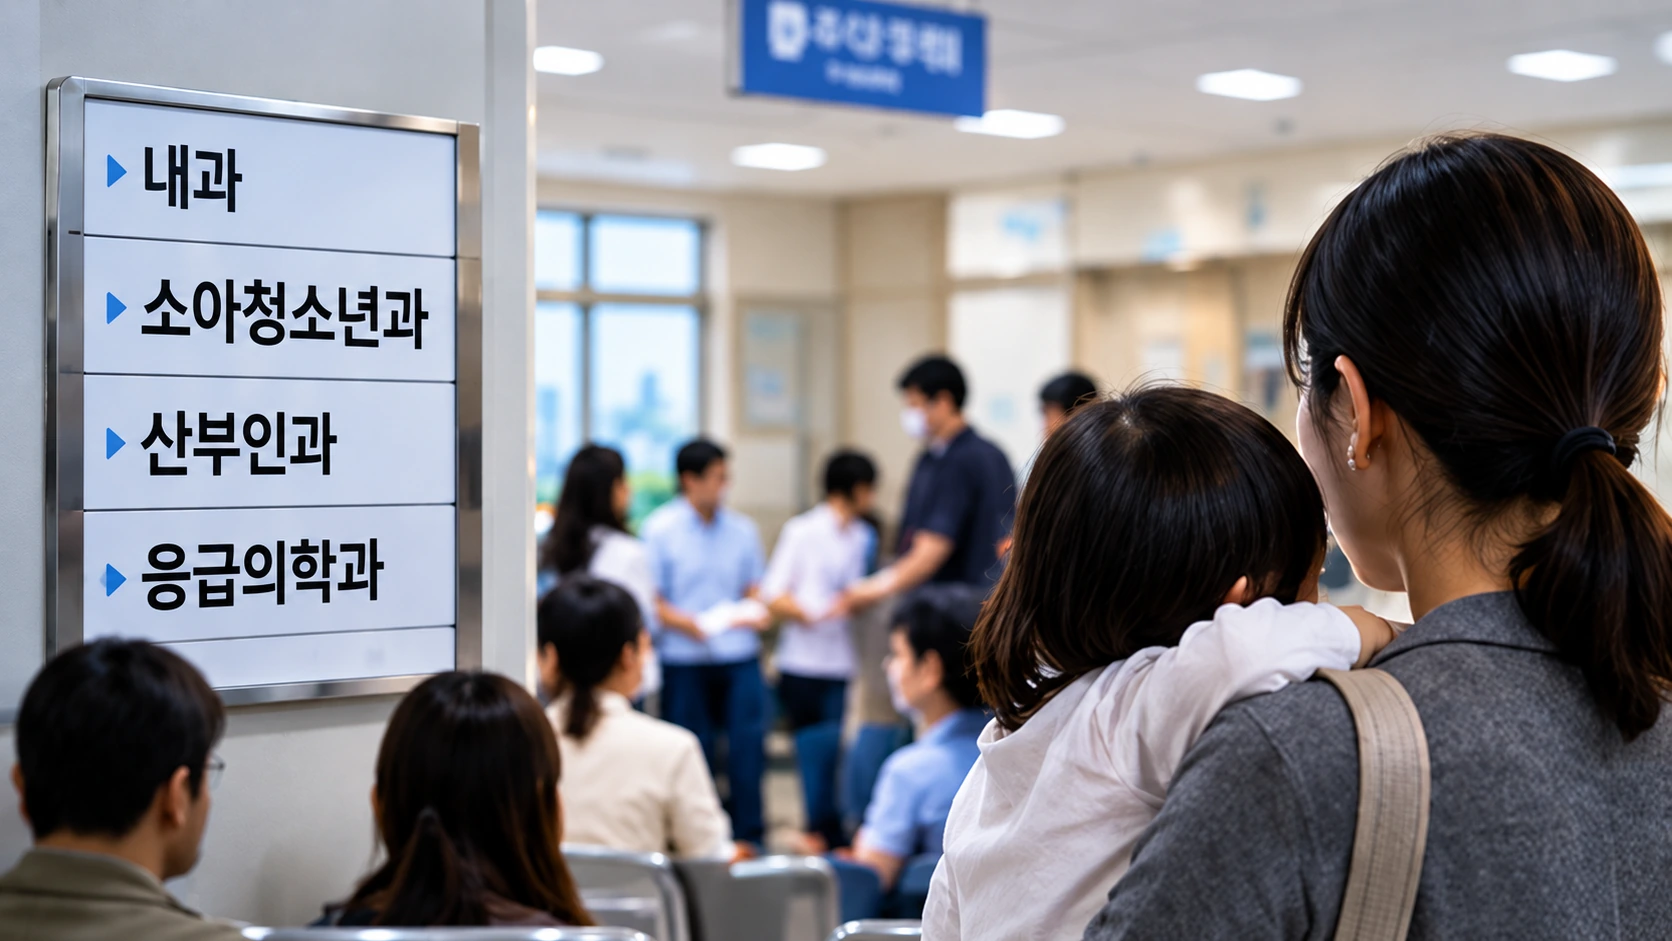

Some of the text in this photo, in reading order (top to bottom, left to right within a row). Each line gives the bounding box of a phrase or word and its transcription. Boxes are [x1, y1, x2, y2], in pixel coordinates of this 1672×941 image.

[144, 144, 243, 213] 내과
[141, 278, 429, 350] 소아청소년과
[140, 410, 338, 477] 산부인과
[141, 537, 385, 611] 응급의학과
